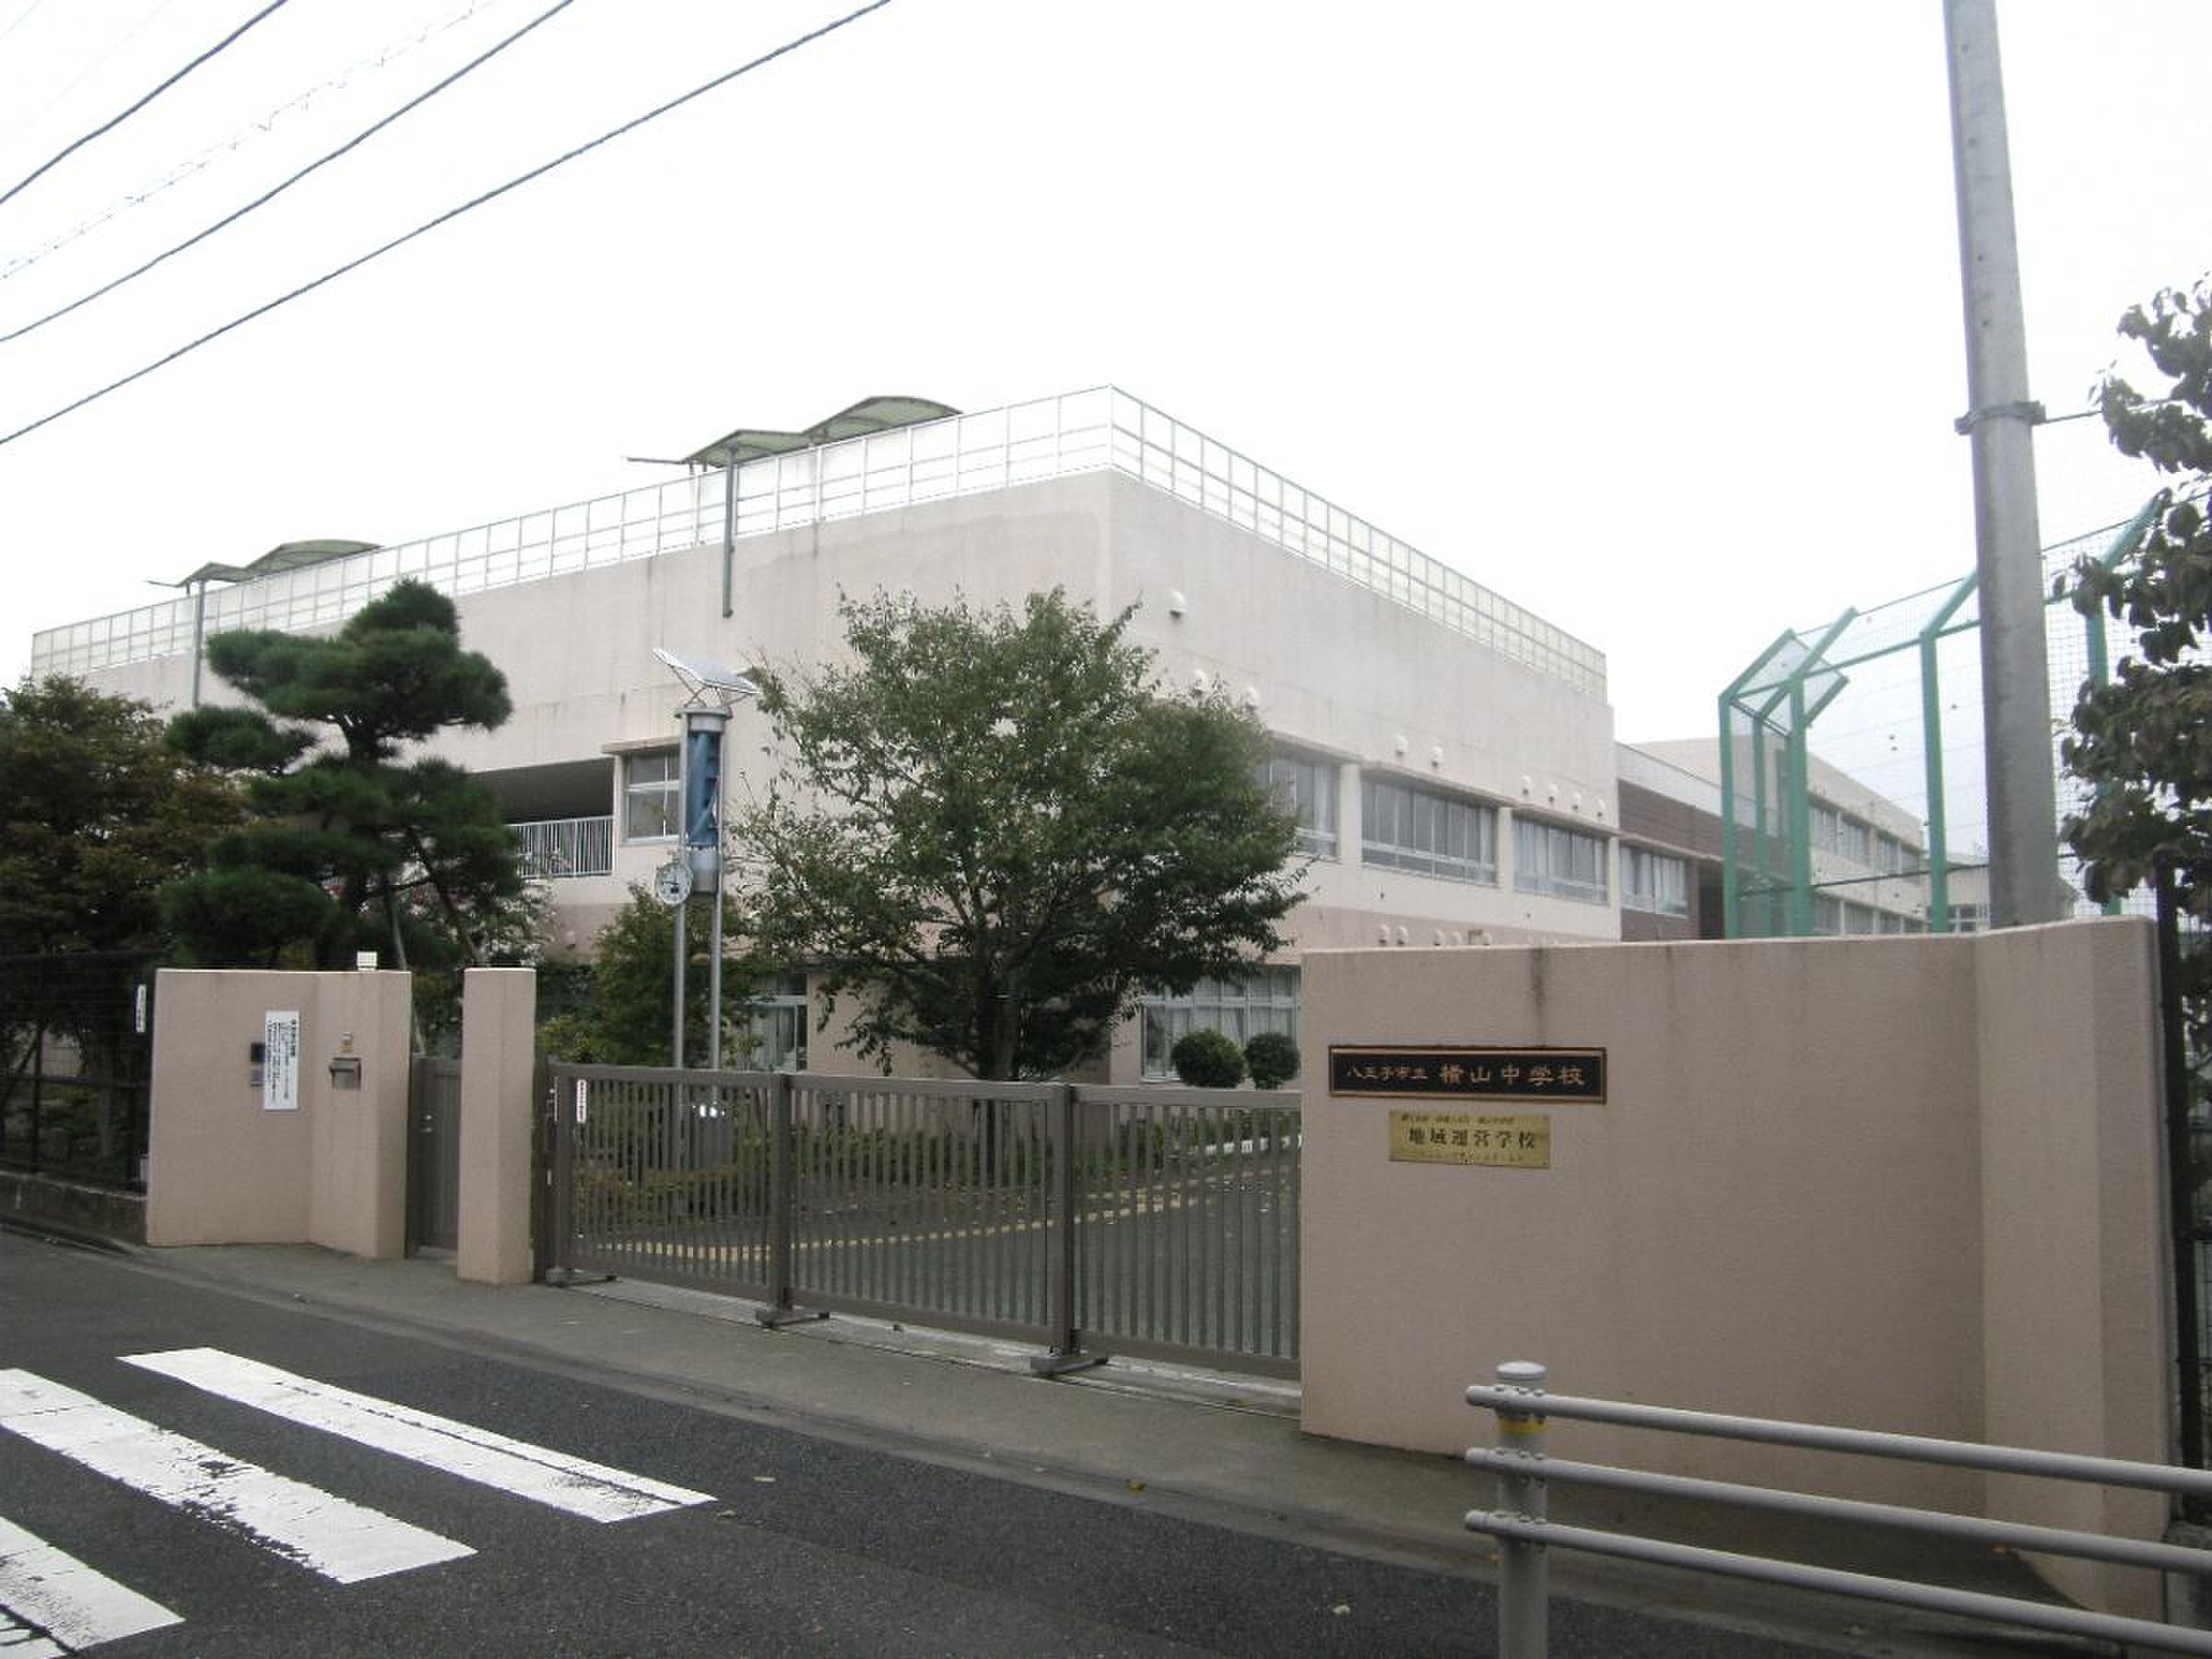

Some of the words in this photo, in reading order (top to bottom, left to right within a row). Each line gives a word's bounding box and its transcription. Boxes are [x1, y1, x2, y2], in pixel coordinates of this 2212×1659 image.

[1439, 1063, 1585, 1087] 横山中学校
[1408, 1126, 1535, 1149] 地域運営学校
